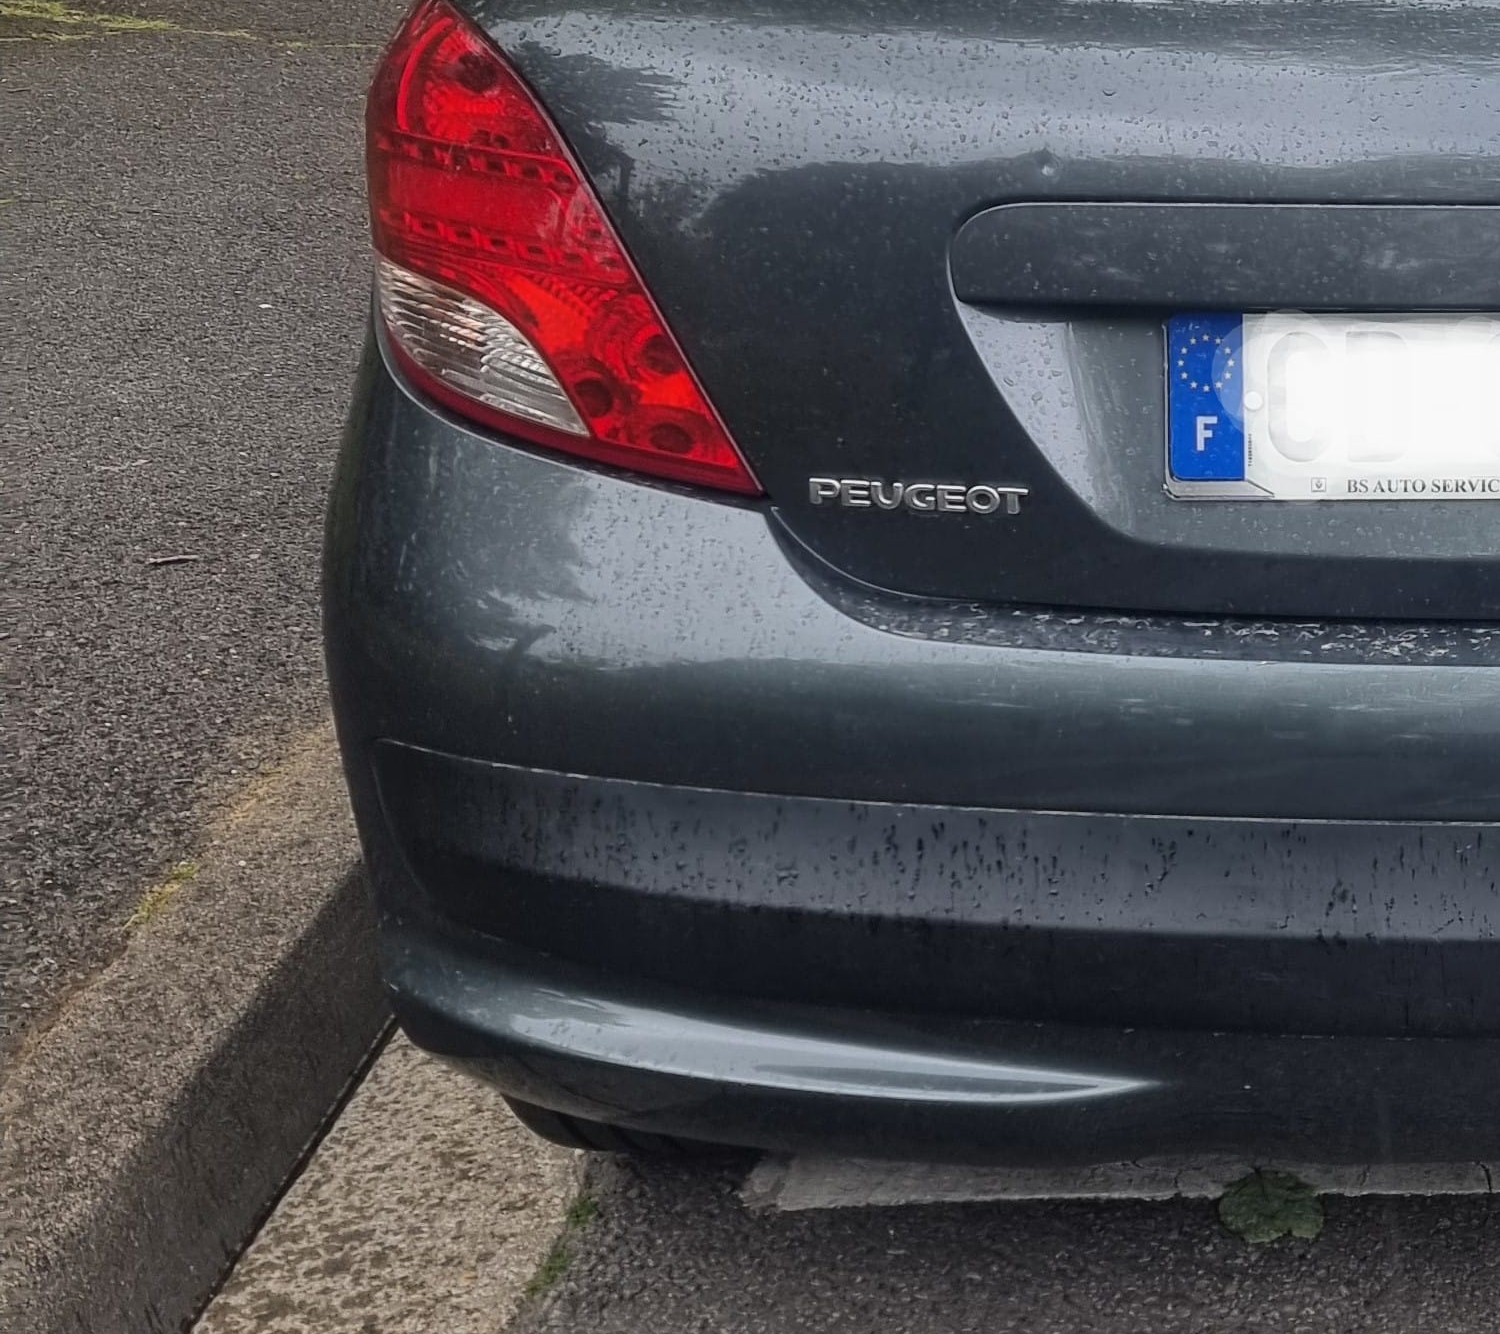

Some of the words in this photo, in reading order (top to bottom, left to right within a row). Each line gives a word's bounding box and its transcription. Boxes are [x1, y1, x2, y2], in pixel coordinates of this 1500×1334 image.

[1196, 416, 1218, 451] F
[808, 477, 1029, 515] PEUGEOT
[1347, 479, 1369, 493] BS
[1373, 479, 1426, 493] AUTO
